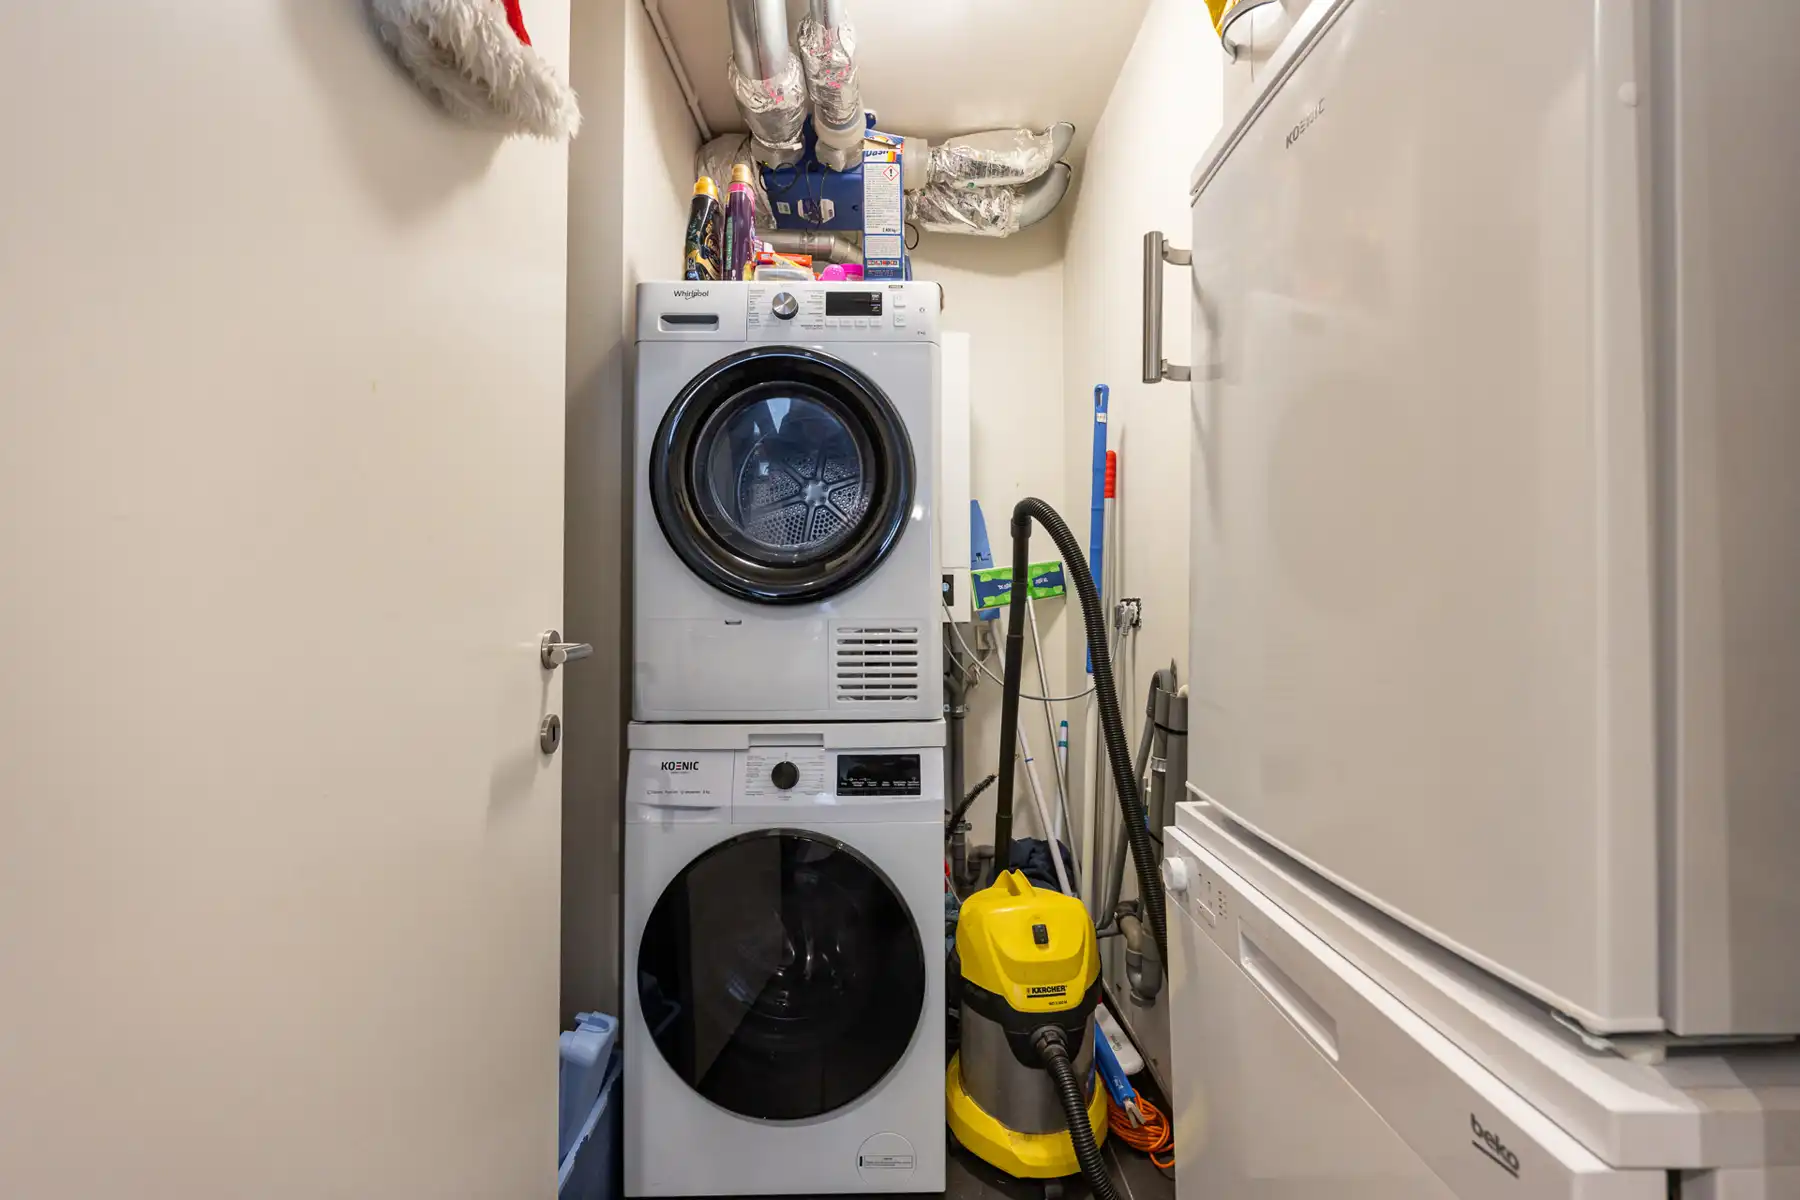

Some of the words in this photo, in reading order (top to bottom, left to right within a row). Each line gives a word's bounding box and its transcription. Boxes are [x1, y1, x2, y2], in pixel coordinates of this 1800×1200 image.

[674, 289, 709, 300] Whirlpool
[661, 761, 700, 771] KOENIC
[1470, 1112, 1520, 1171] beko
